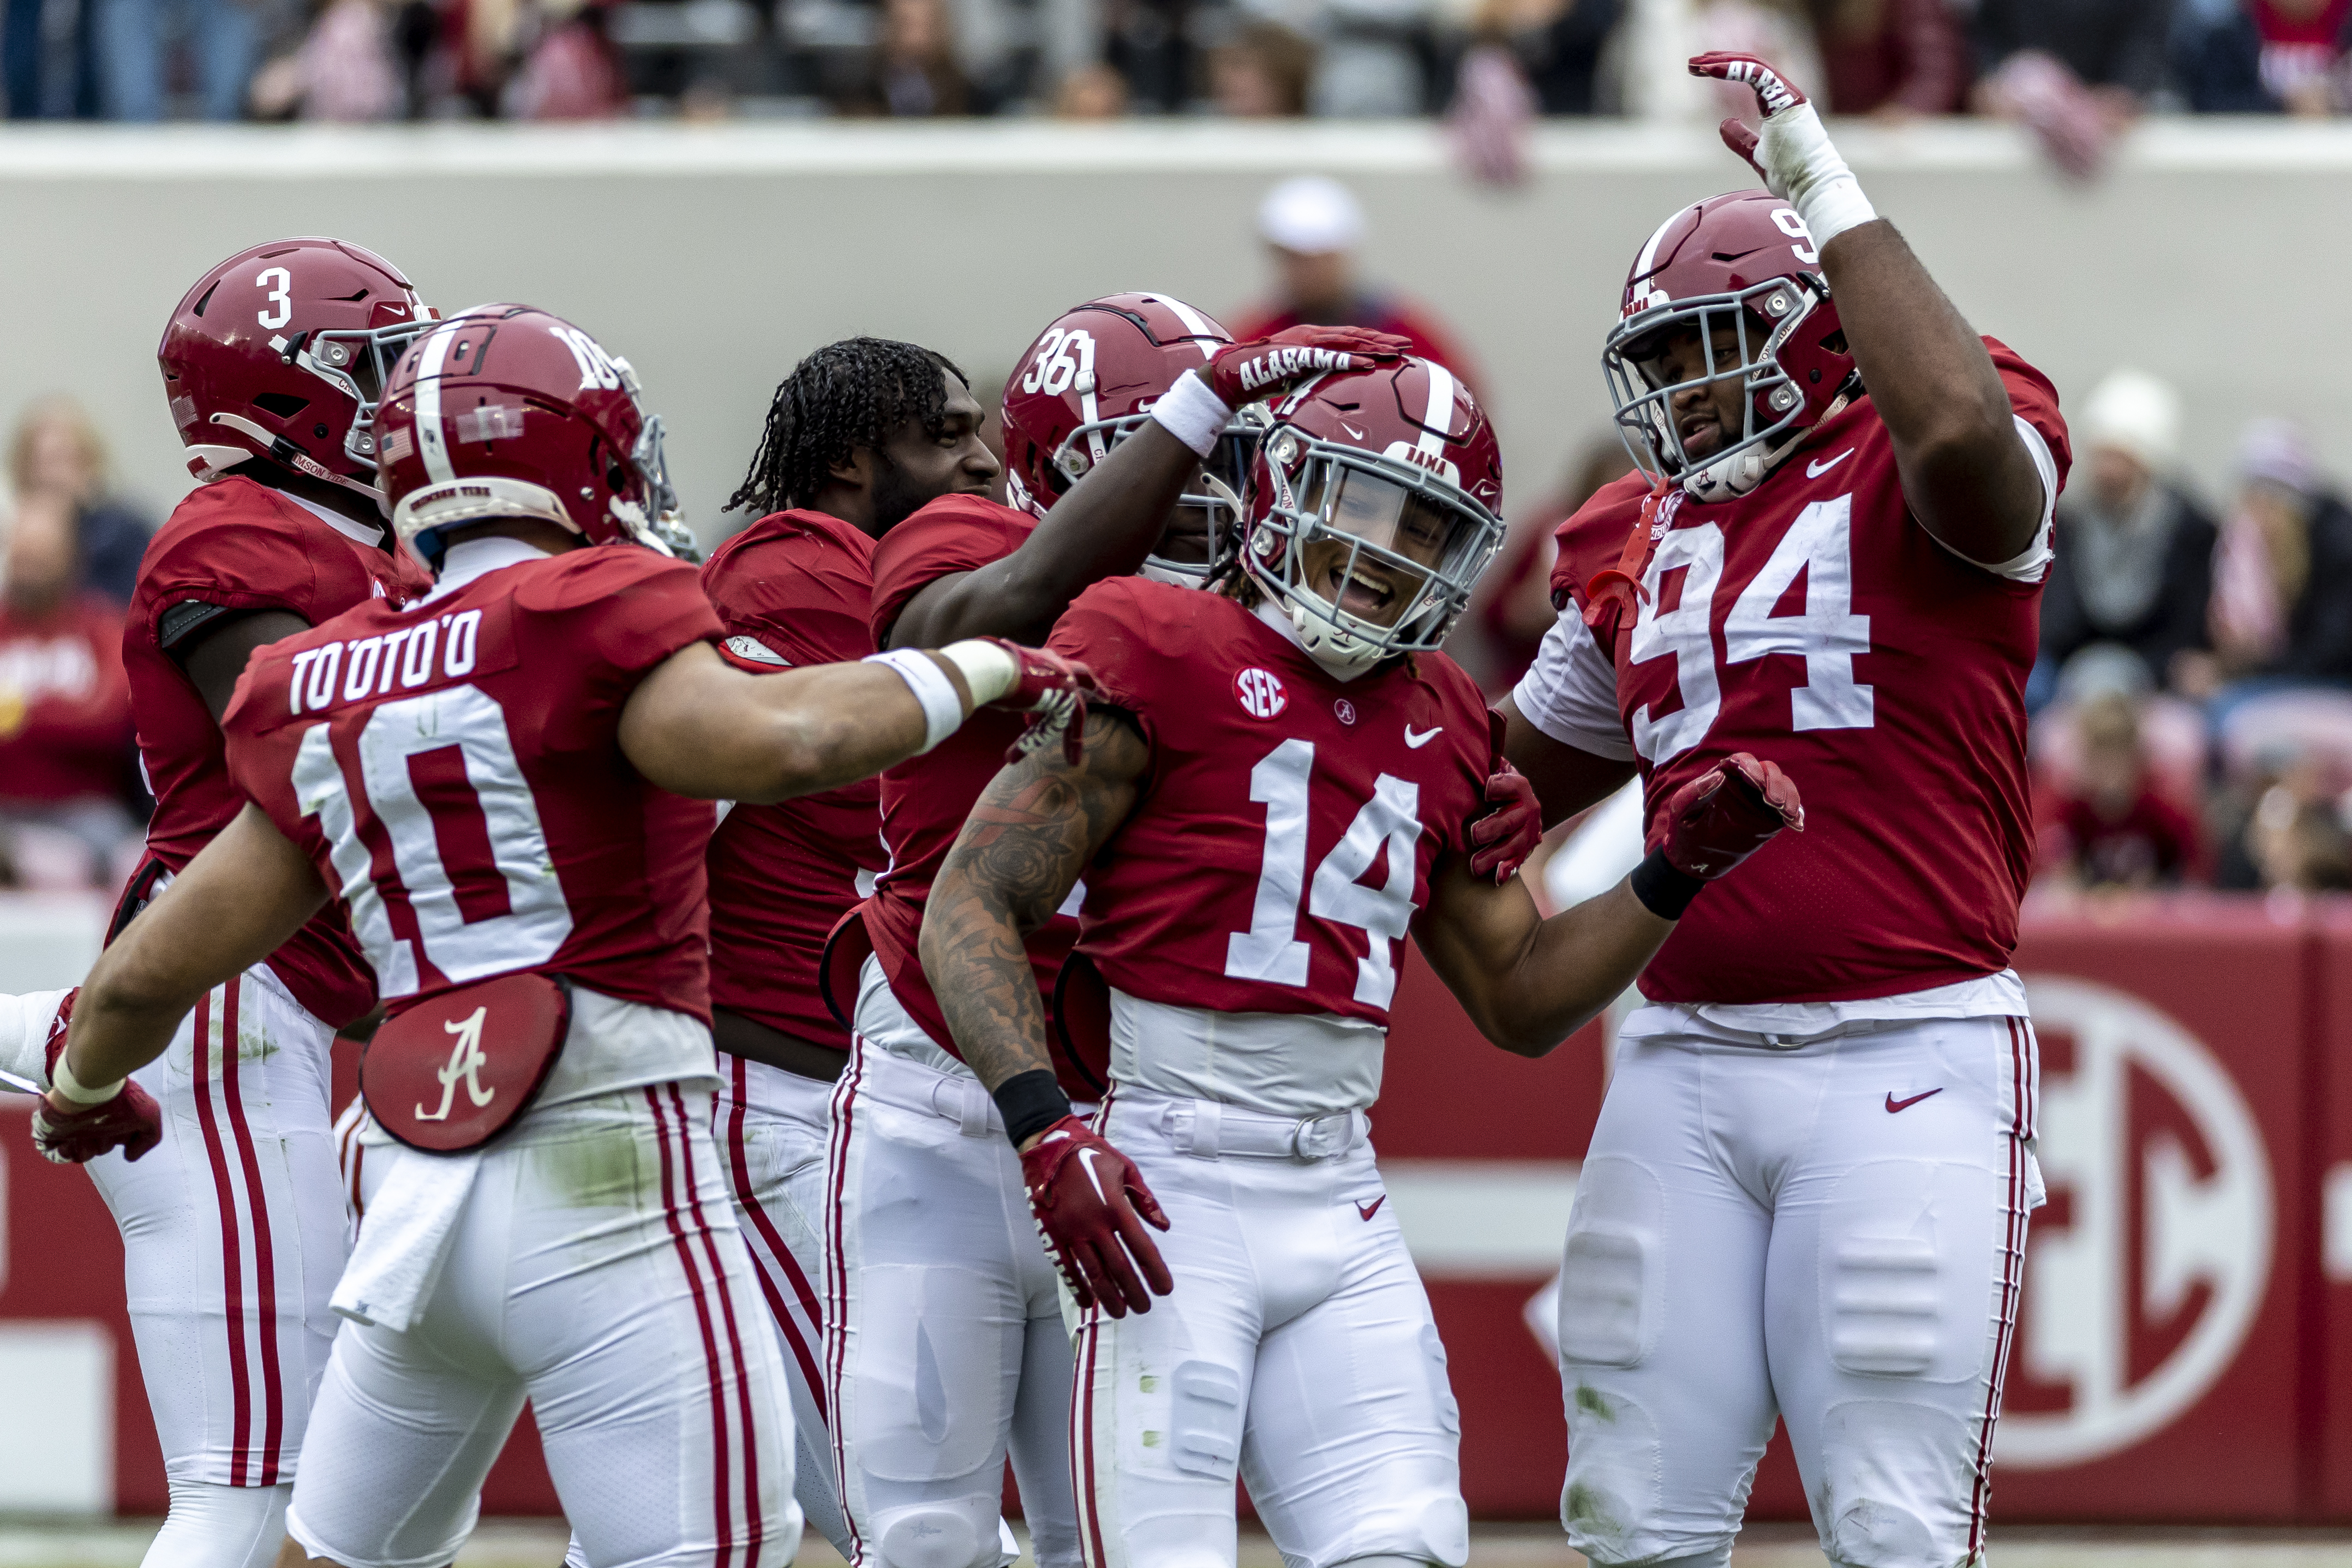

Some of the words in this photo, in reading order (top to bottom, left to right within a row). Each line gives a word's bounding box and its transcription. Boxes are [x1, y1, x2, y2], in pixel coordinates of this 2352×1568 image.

[1770, 208, 1819, 265] 9
[256, 267, 292, 330] 3
[548, 327, 620, 391] 10
[1022, 327, 1090, 397] 36
[1240, 346, 1352, 392] ALABAMA
[327, 472, 349, 485] TIDE
[1405, 446, 1447, 477] BAMA
[1630, 492, 1875, 766] 94
[290, 608, 482, 716] TO'OTO'O
[1237, 667, 1285, 717] SEC
[290, 683, 574, 1000] 10
[1224, 738, 1423, 1013] 14
